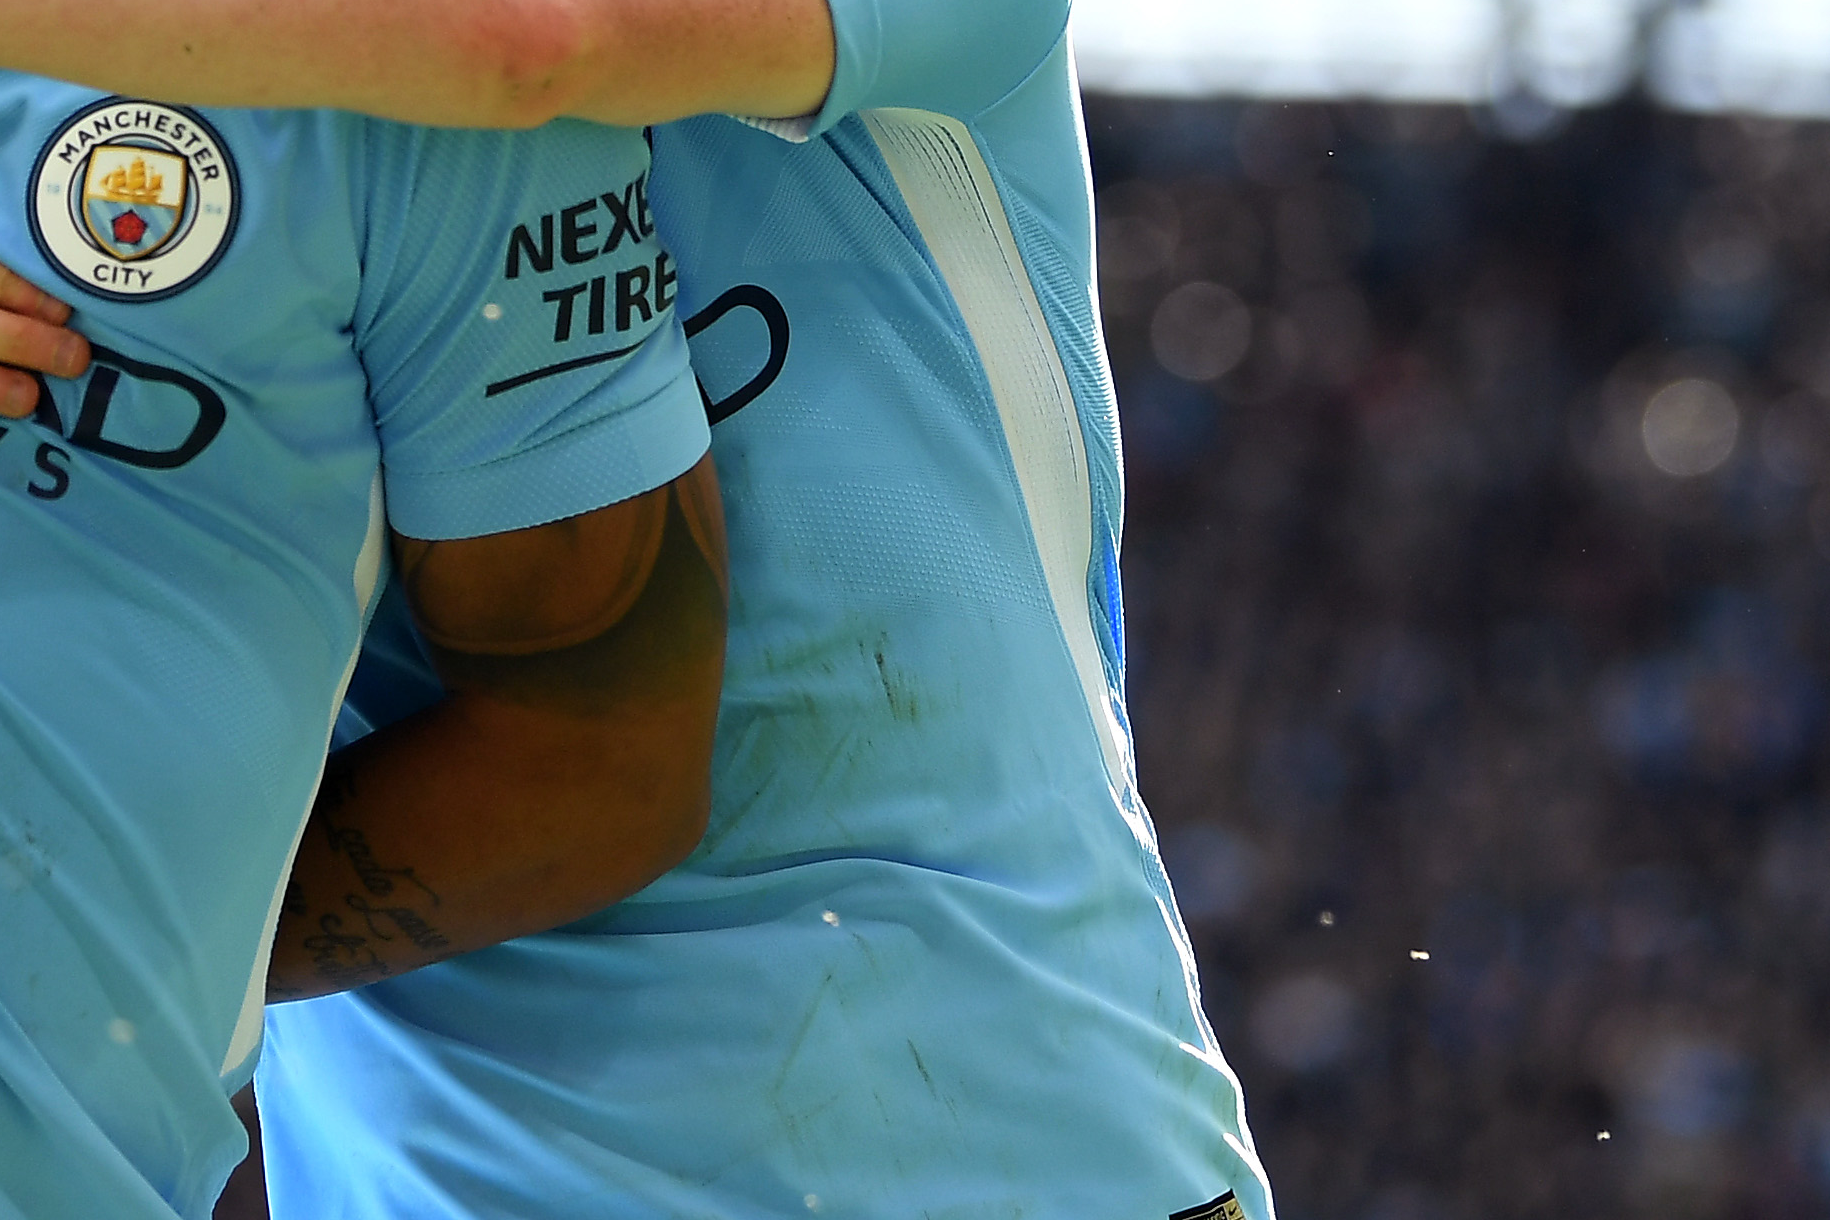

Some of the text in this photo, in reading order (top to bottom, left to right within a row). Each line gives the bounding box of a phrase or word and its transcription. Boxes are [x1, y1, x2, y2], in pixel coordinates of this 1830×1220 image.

[58, 111, 220, 182] MANCHESTER
[92, 264, 154, 288] CITY
[543, 250, 677, 342] TIRE
